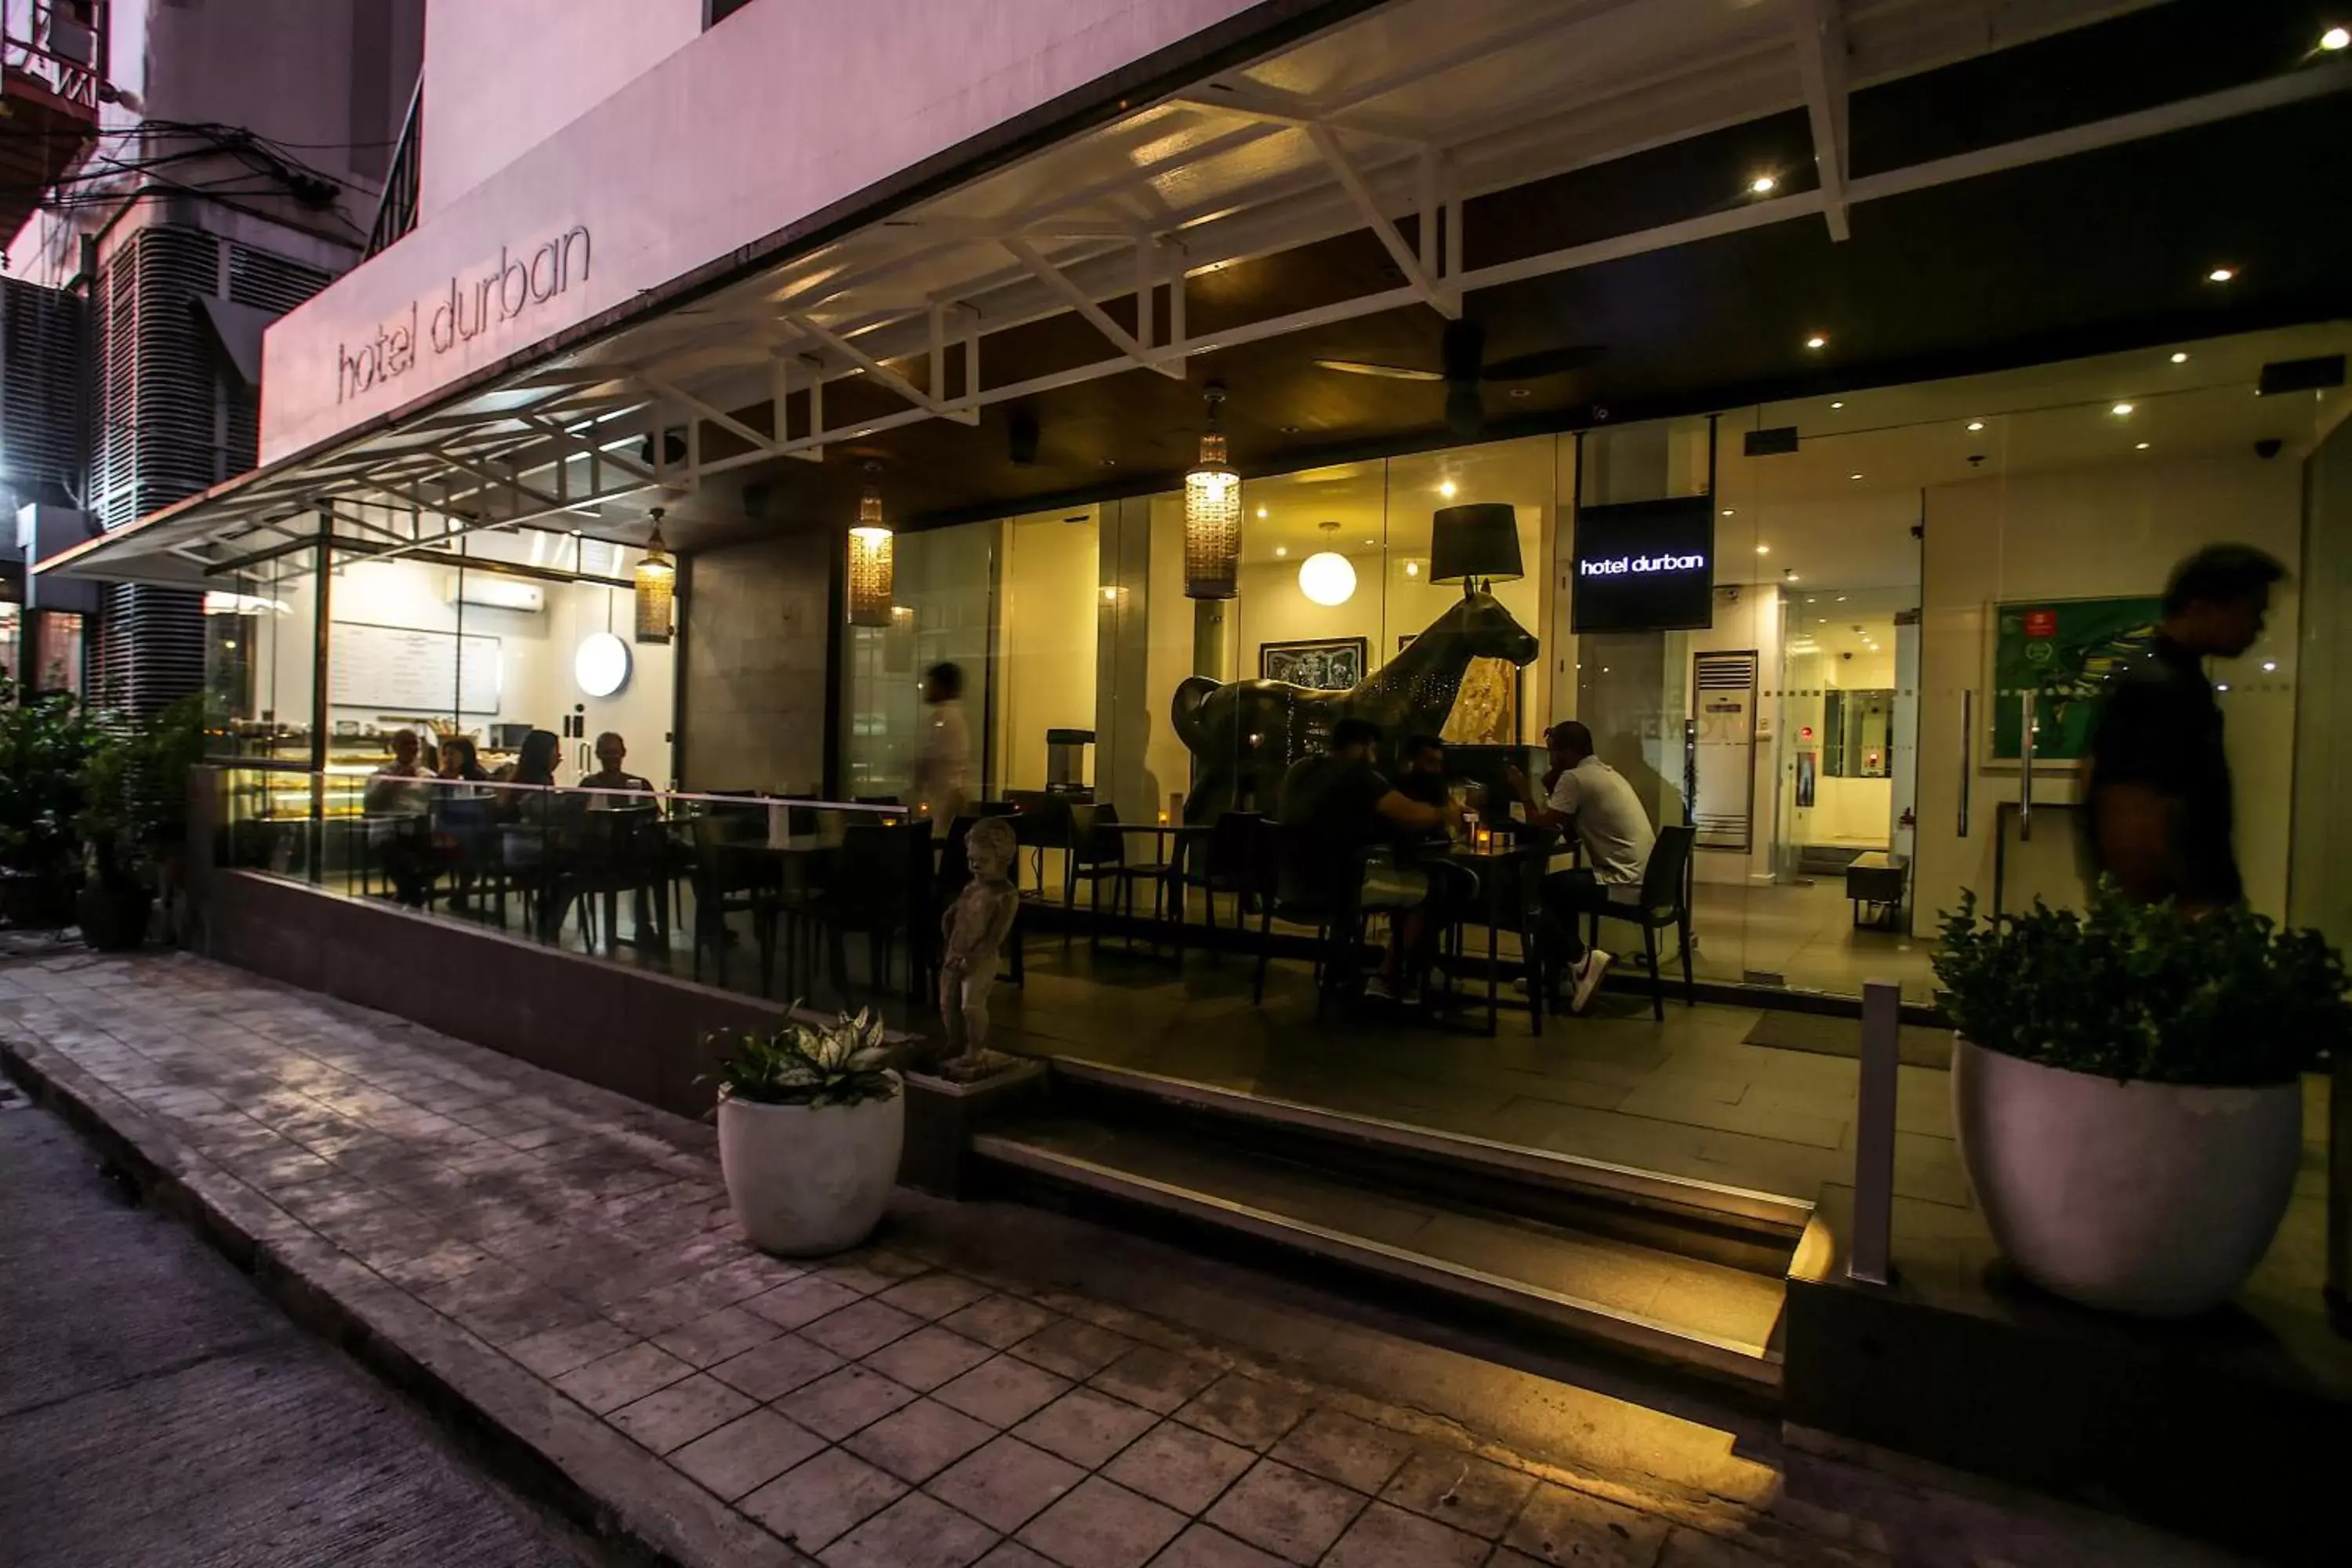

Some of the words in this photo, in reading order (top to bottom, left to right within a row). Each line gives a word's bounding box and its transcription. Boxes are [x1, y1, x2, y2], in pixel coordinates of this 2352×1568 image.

[337, 300, 417, 405] hotel
[431, 225, 590, 354] durban
[1581, 556, 1628, 575] hotel
[1632, 554, 1704, 572] durban
